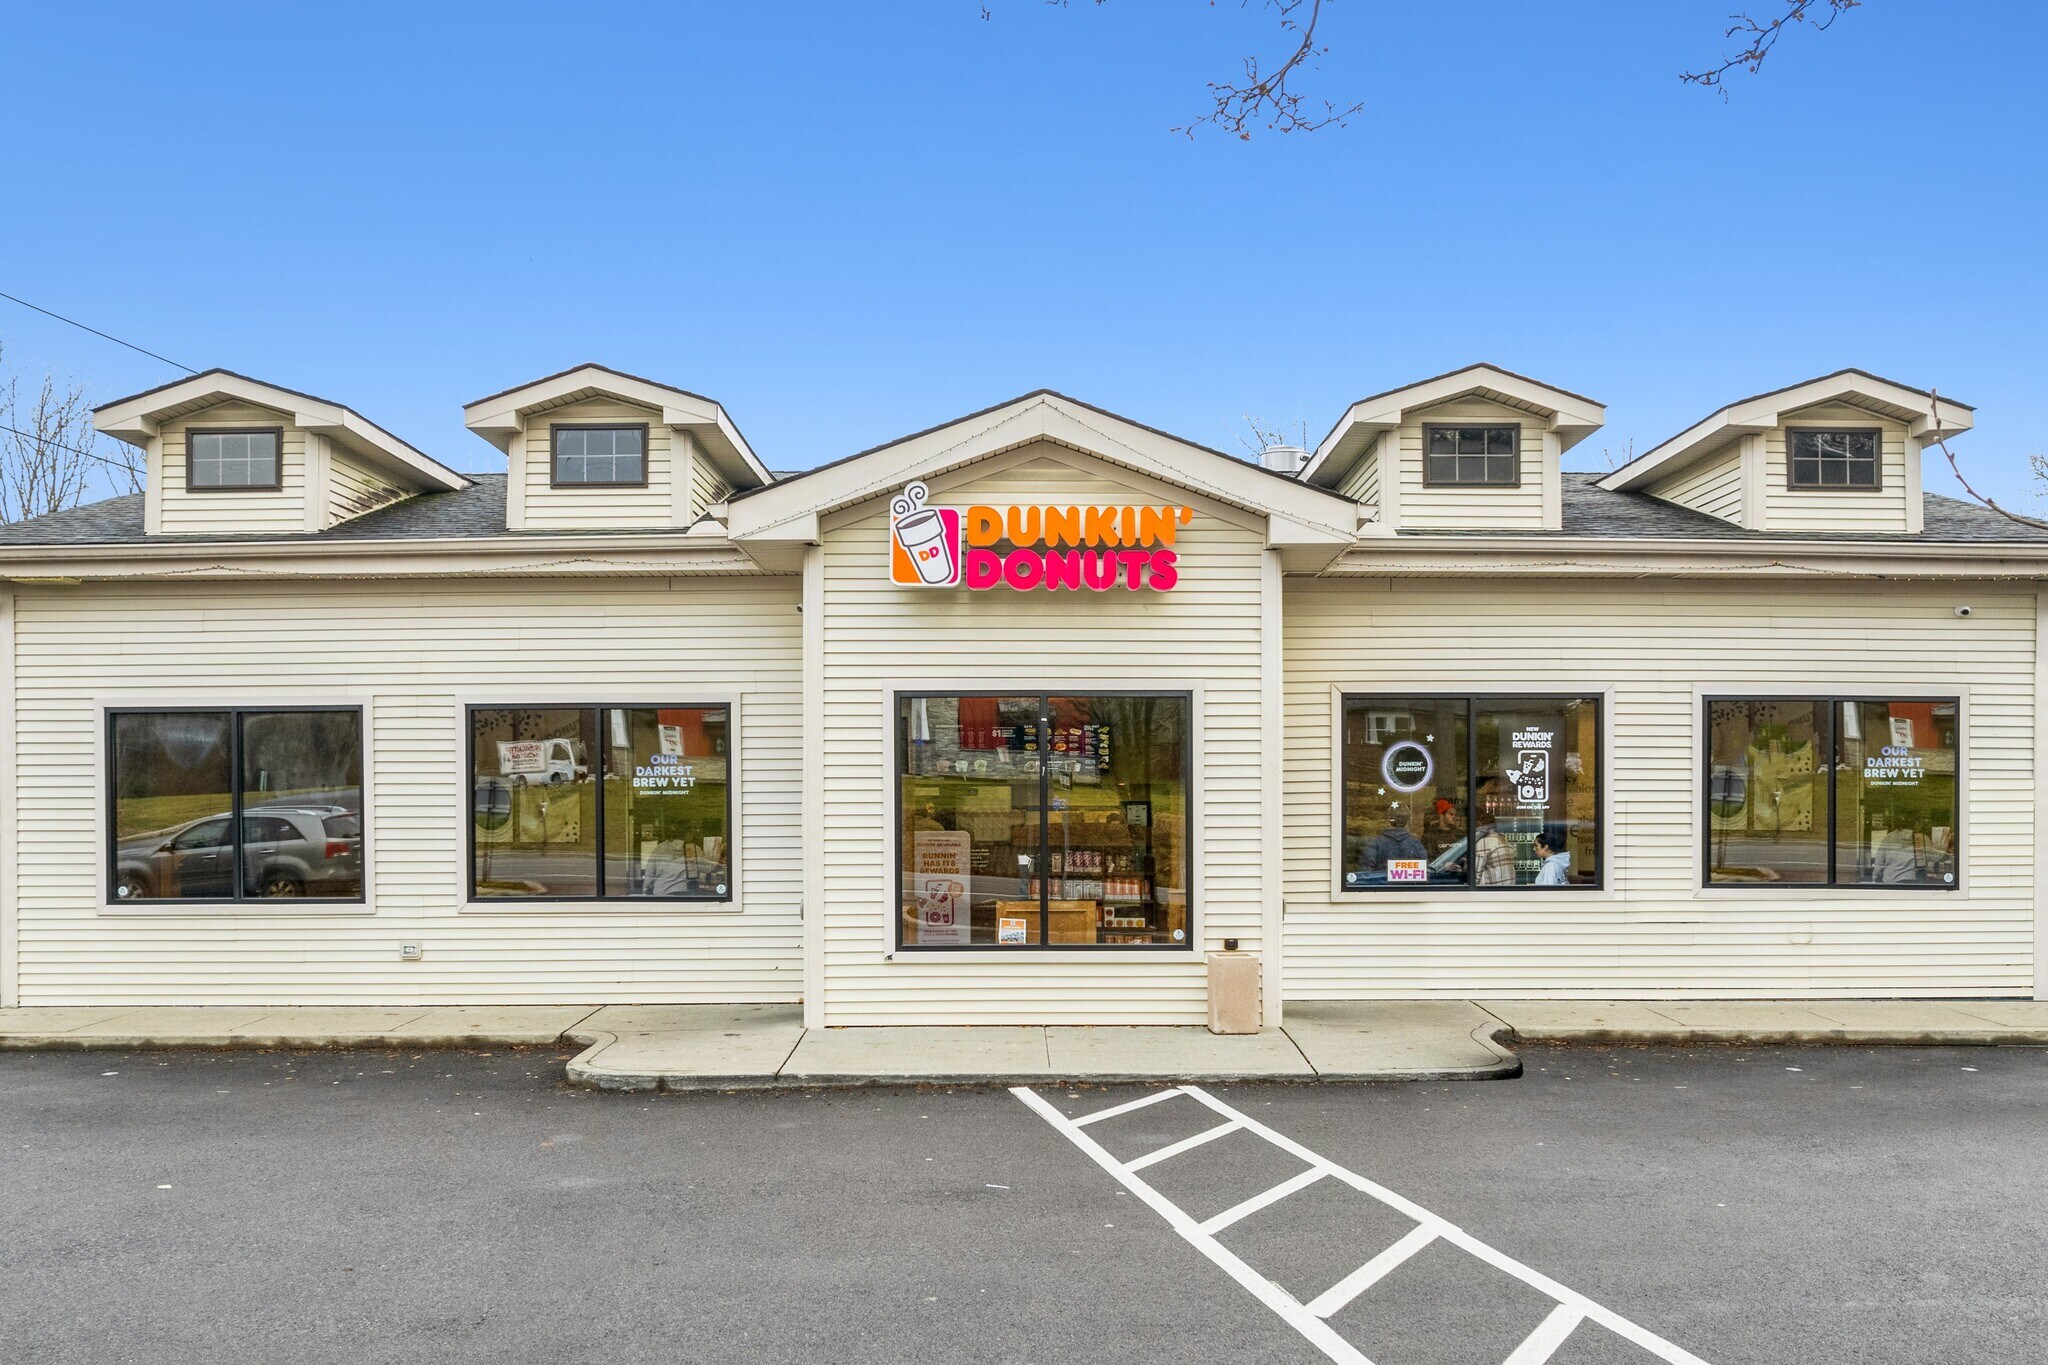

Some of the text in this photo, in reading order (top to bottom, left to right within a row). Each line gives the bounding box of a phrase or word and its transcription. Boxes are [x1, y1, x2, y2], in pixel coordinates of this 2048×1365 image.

[967, 505, 1193, 548] DUNKIN'
[919, 546, 940, 562] DD
[965, 549, 1179, 592] DONUTS
[1512, 732, 1554, 741] DUNKIN'
[1512, 741, 1552, 749] REWARDS
[1881, 746, 1908, 756] OUR
[650, 754, 678, 765] OUR
[1867, 757, 1922, 767] DARKEST
[636, 765, 693, 776] DARKEST
[1864, 768, 1925, 778] BREW YET
[632, 777, 696, 787] BREW YET
[922, 852, 958, 860] RUNNIN'
[1390, 869, 1425, 880] WI-FI
